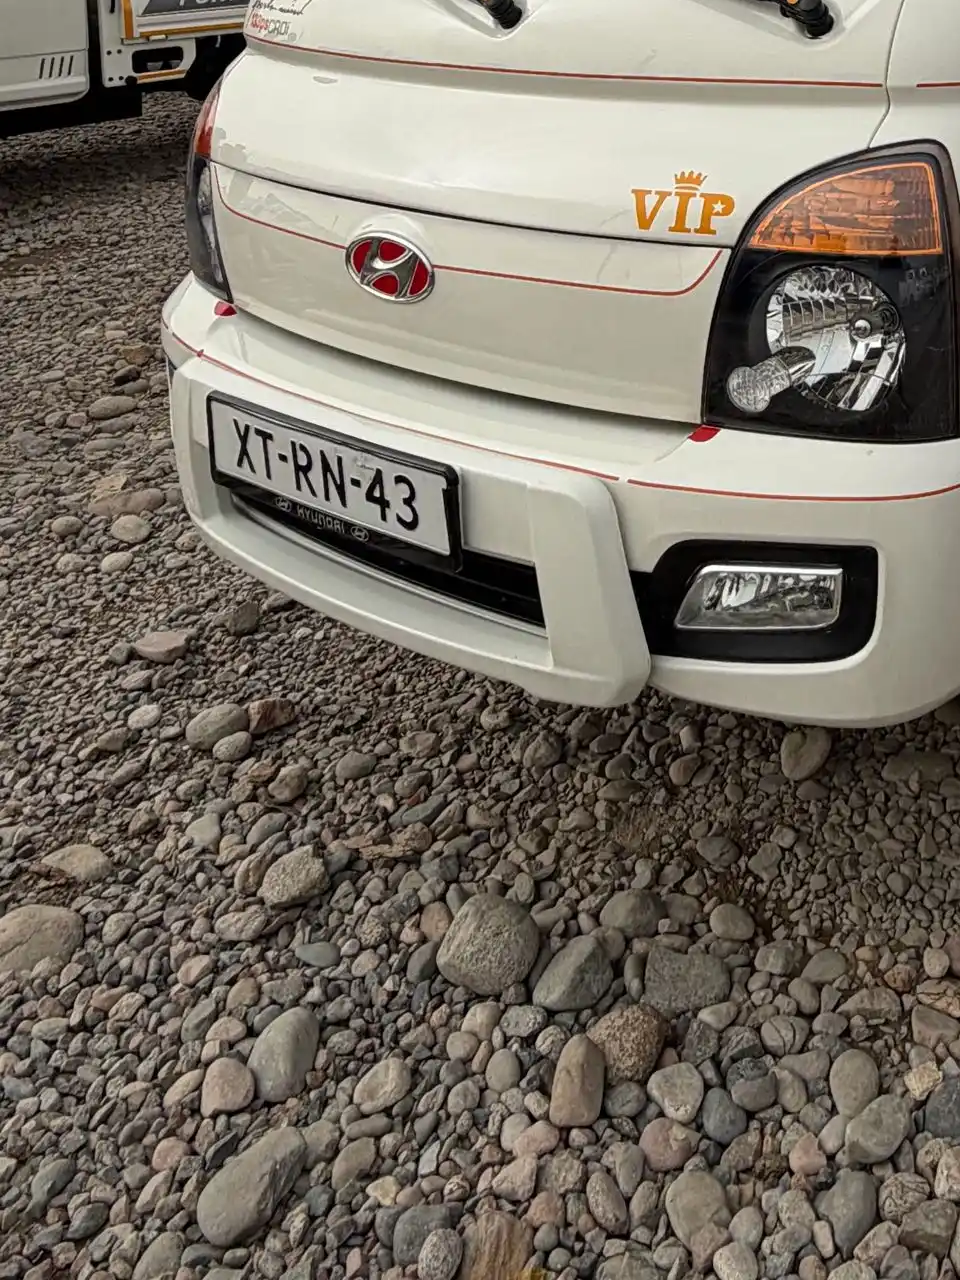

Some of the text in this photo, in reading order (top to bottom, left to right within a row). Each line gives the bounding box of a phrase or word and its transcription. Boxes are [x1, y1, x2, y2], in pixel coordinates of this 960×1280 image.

[631, 188, 736, 236] VIP
[232, 417, 420, 532] XT-RN-43
[296, 504, 346, 534] HYUNDAI
